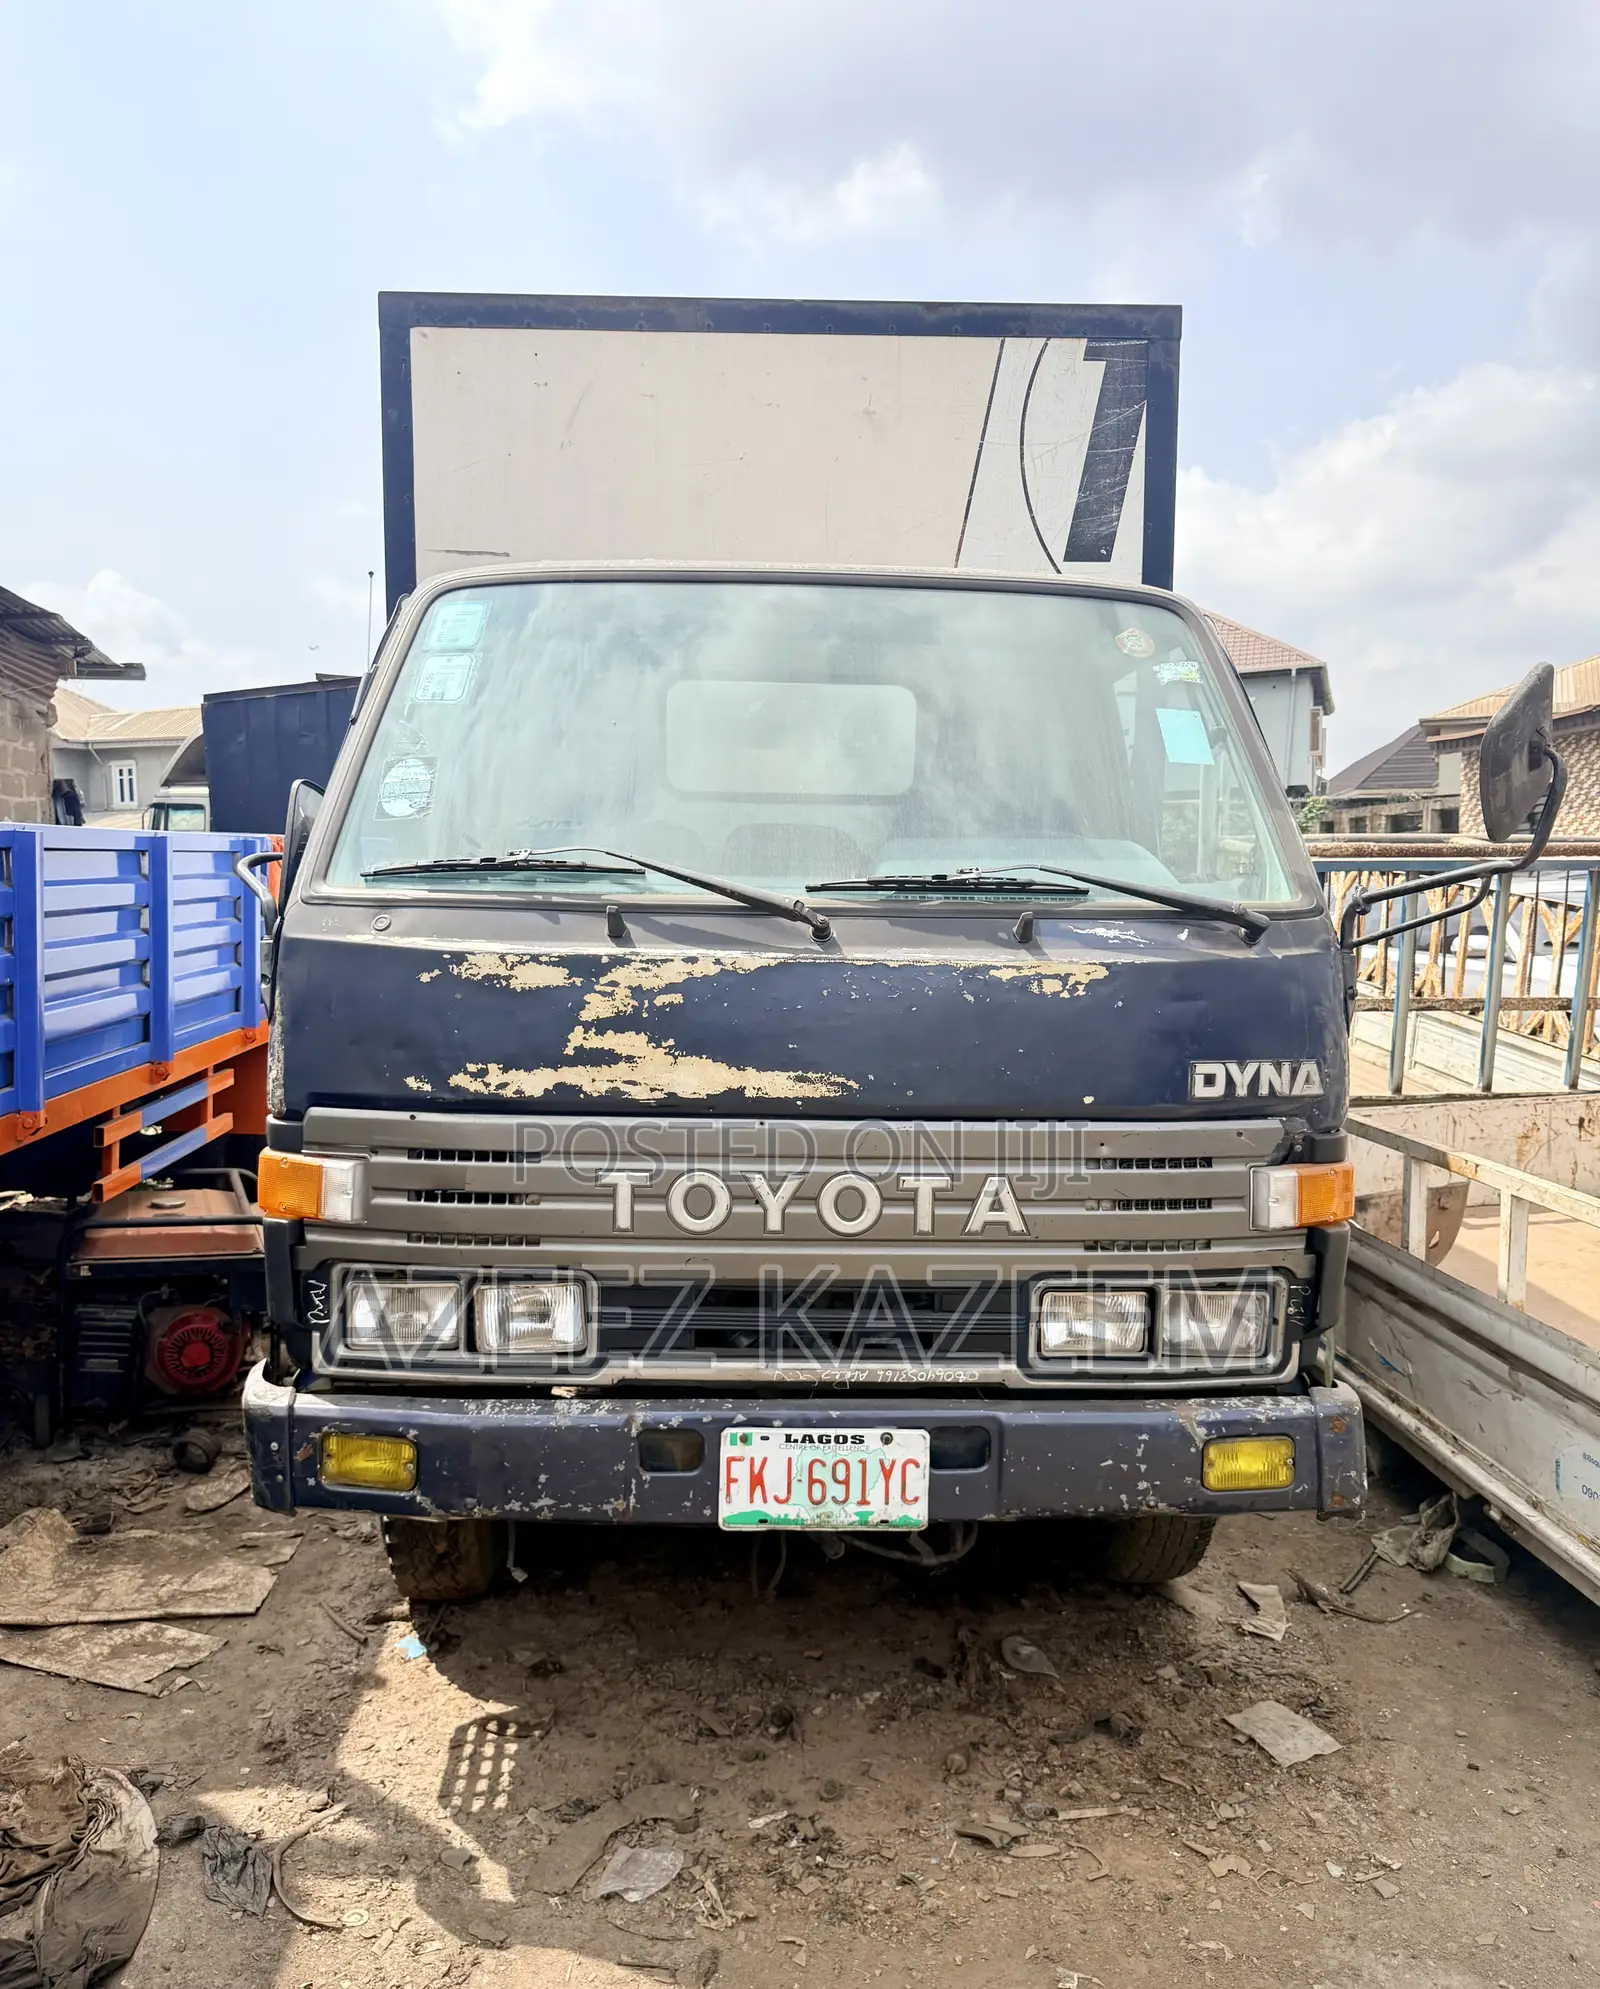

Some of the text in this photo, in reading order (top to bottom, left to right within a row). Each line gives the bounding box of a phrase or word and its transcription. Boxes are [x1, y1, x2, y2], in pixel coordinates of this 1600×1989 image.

[1189, 1059, 1325, 1098] DYNA
[595, 1167, 1031, 1237] TOYOTA
[784, 1433, 866, 1445] LAGOS
[822, 1444, 872, 1452] EXCELLENCE
